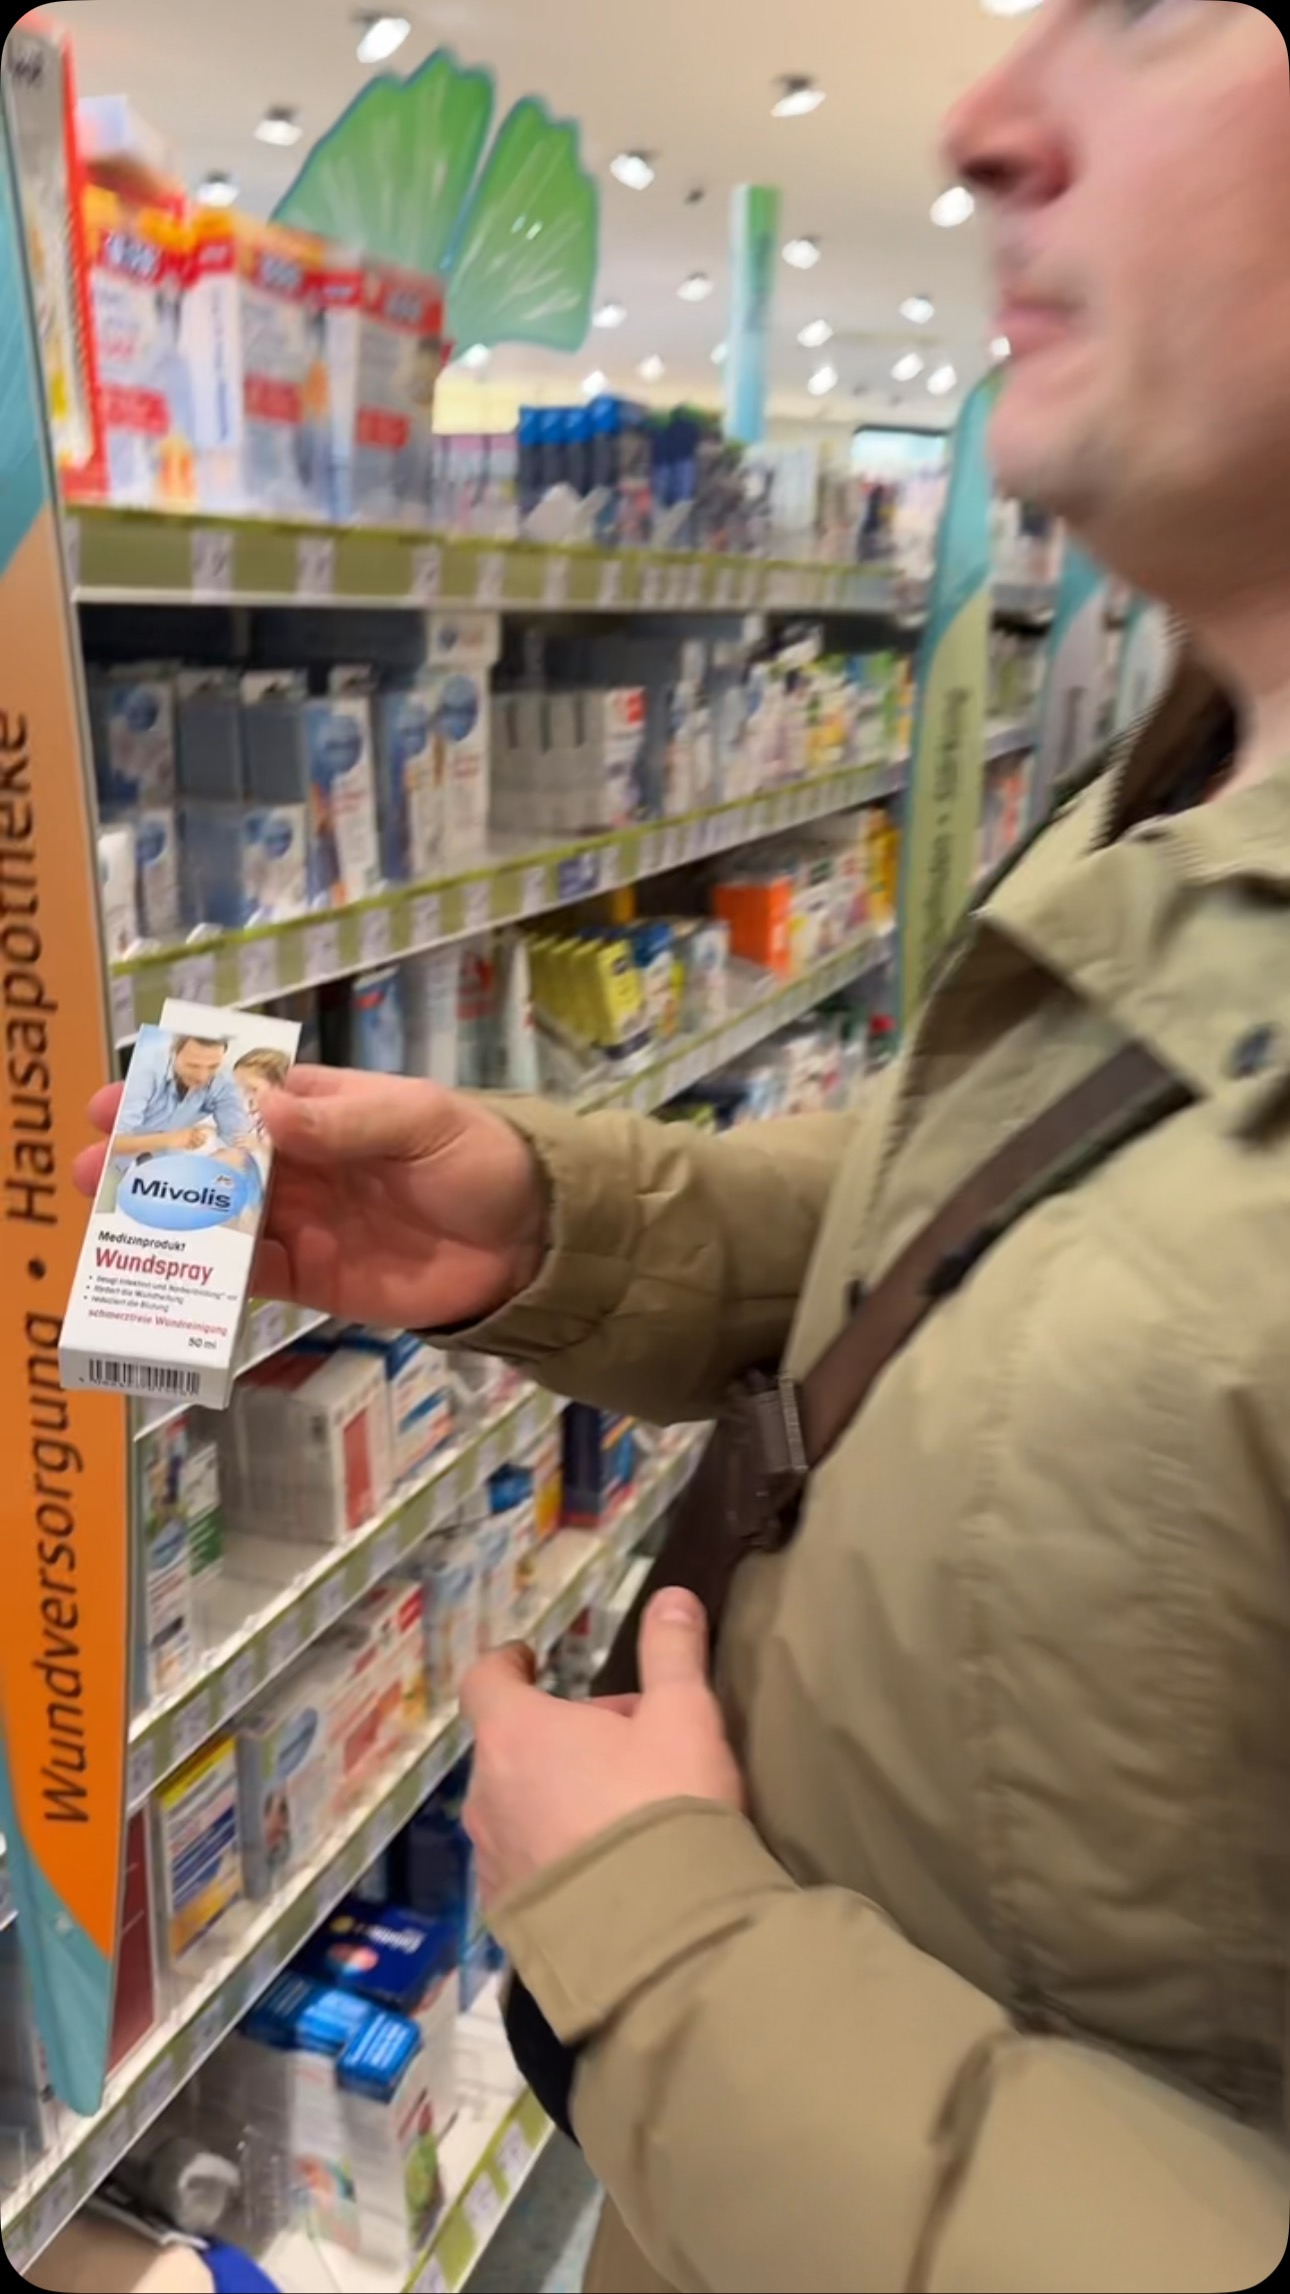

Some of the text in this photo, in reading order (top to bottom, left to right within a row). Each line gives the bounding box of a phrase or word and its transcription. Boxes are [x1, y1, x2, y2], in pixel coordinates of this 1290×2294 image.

[132, 1177, 232, 1209] Mivolis
[98, 1230, 187, 1252] Medizinprodukt
[95, 1246, 214, 1287] Wundspray
[155, 1316, 229, 1337] Wundreinigung
[188, 1336, 203, 1349] 50
[26, 1311, 90, 1823] Wundversorgung
